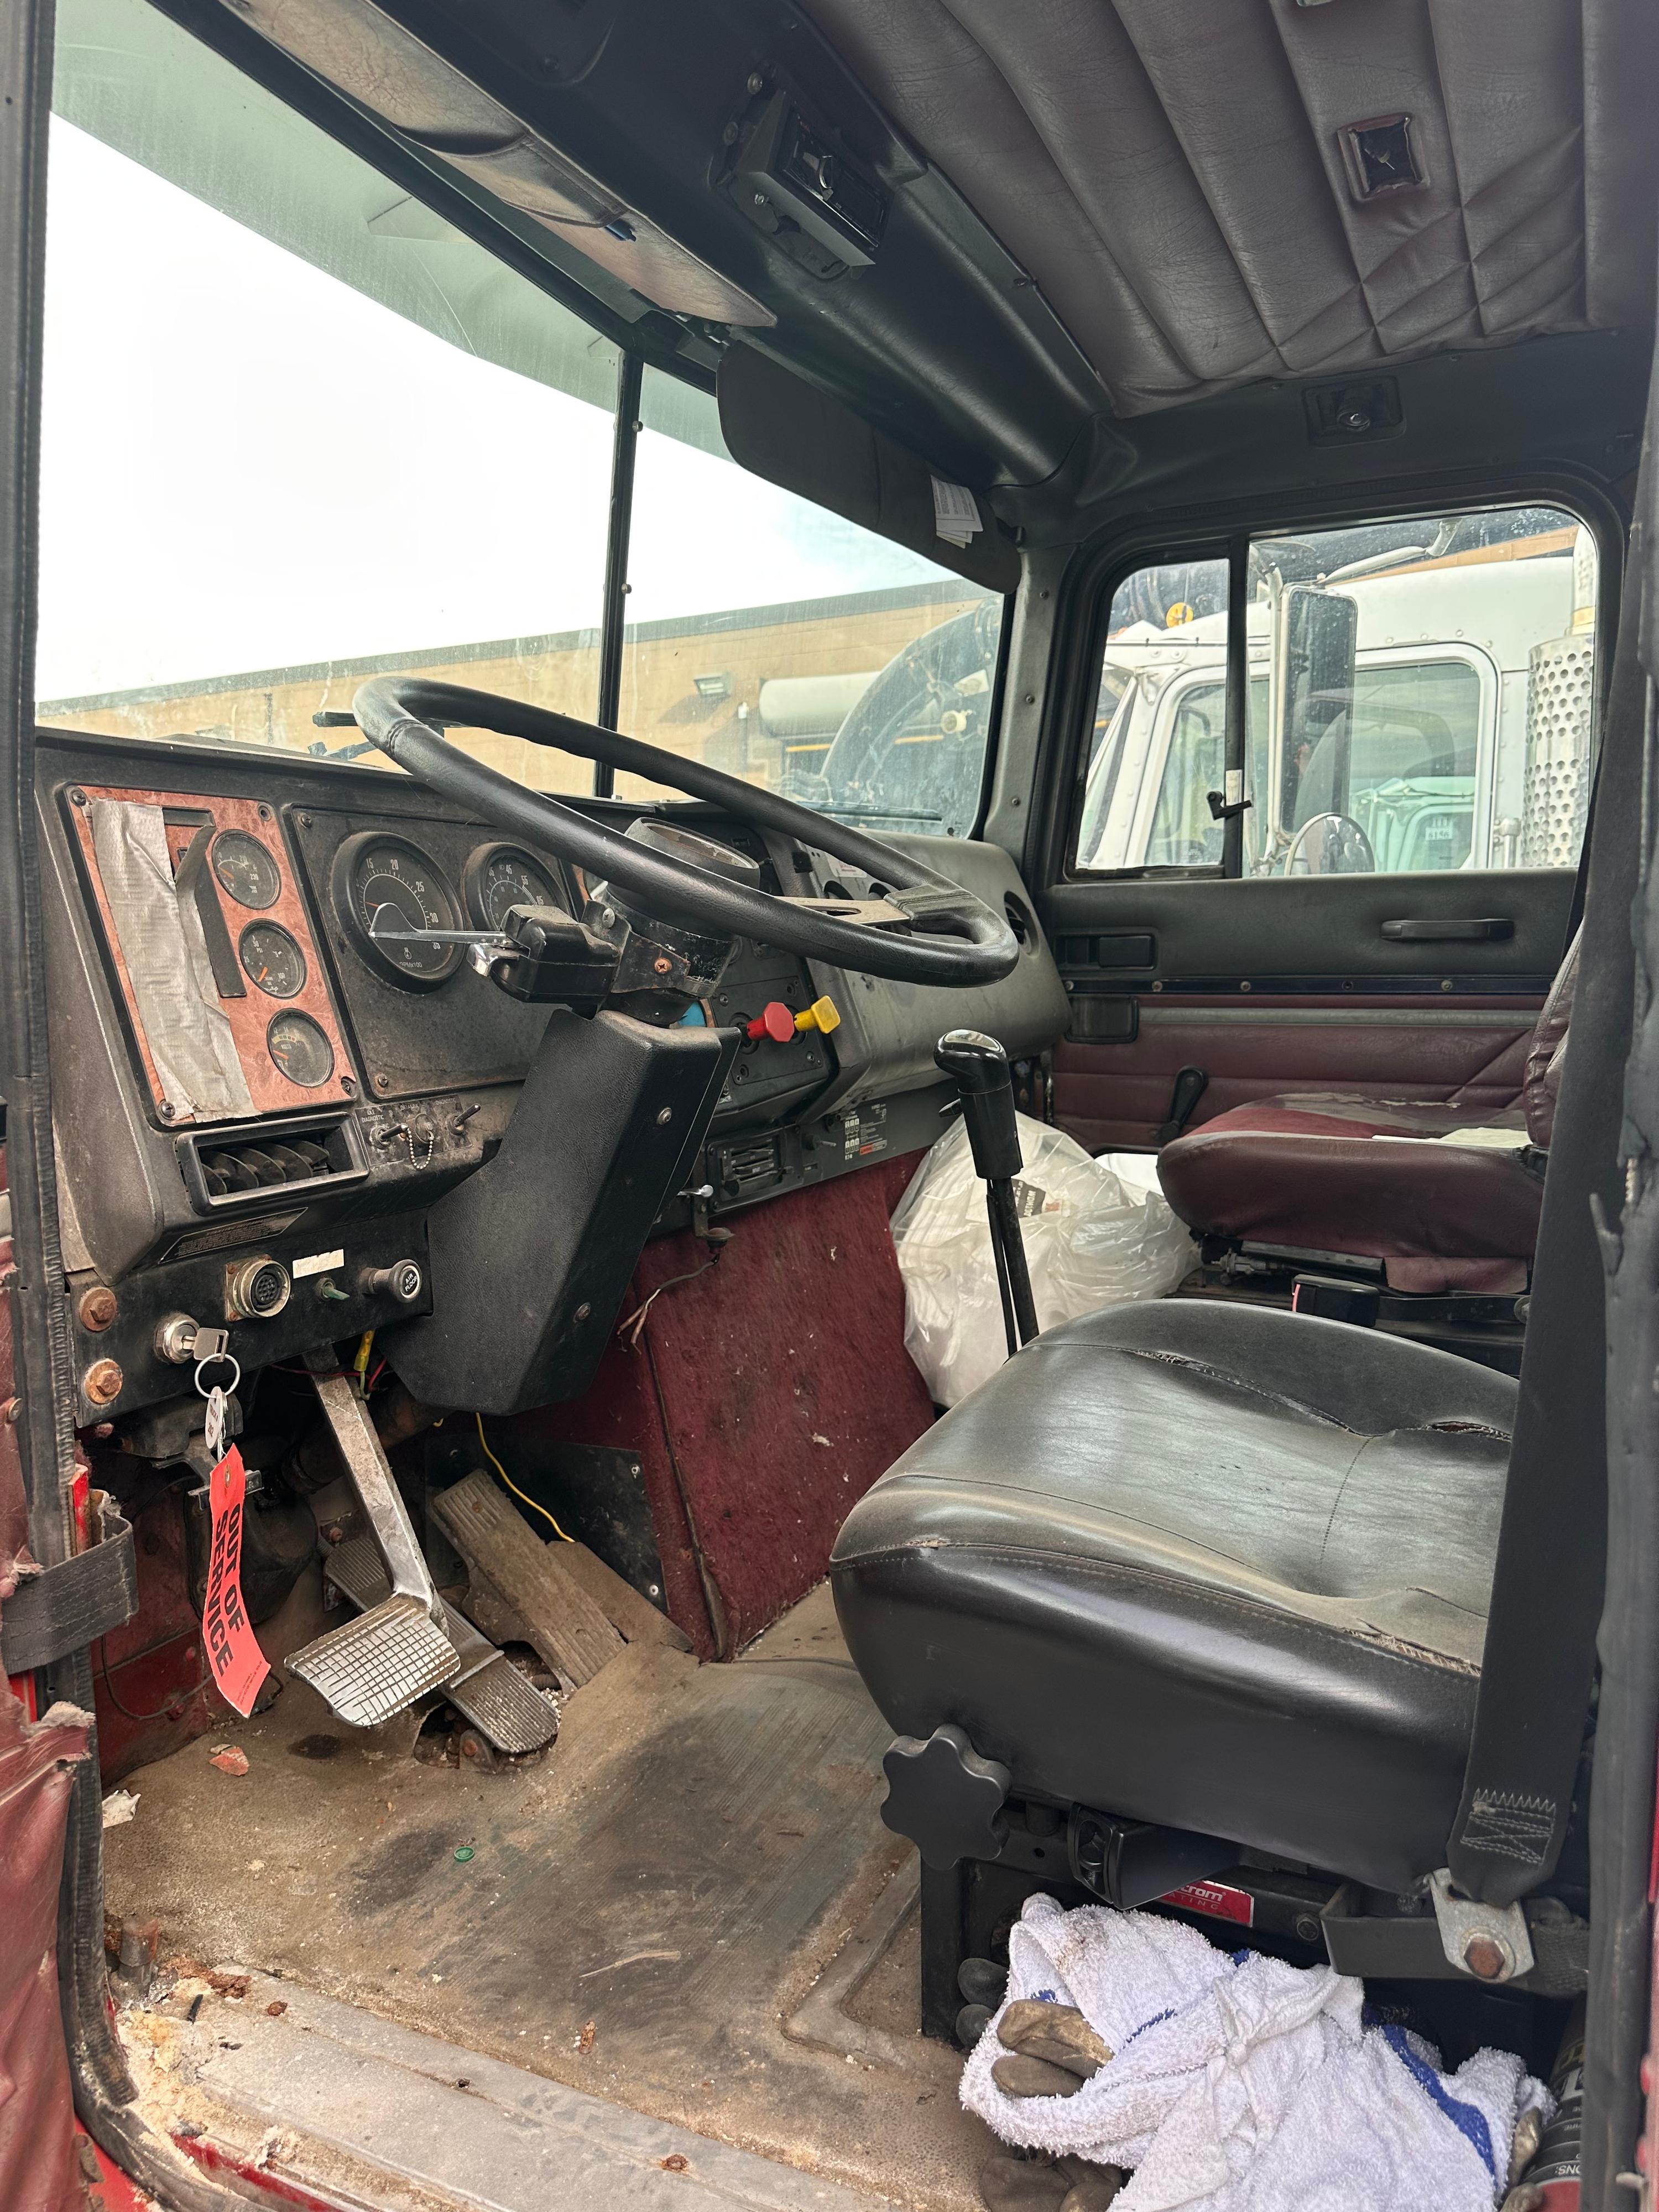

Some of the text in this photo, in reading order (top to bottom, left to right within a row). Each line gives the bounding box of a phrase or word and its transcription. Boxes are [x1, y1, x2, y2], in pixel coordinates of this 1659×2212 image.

[366, 858, 374, 869] 15
[390, 859, 399, 870] 20
[506, 864, 512, 874] 45
[521, 875, 529, 885] 55
[416, 881, 425, 892] 25
[536, 895, 544, 905] 65
[430, 912, 439, 923] 30
[361, 1114, 384, 1123] DIAGNOSTIC
[405, 1273, 414, 1284] AIR
[405, 1276, 418, 1291] FLOOR
[225, 1503, 244, 1632] OUT OF
[208, 1510, 233, 1677] SERVICE
